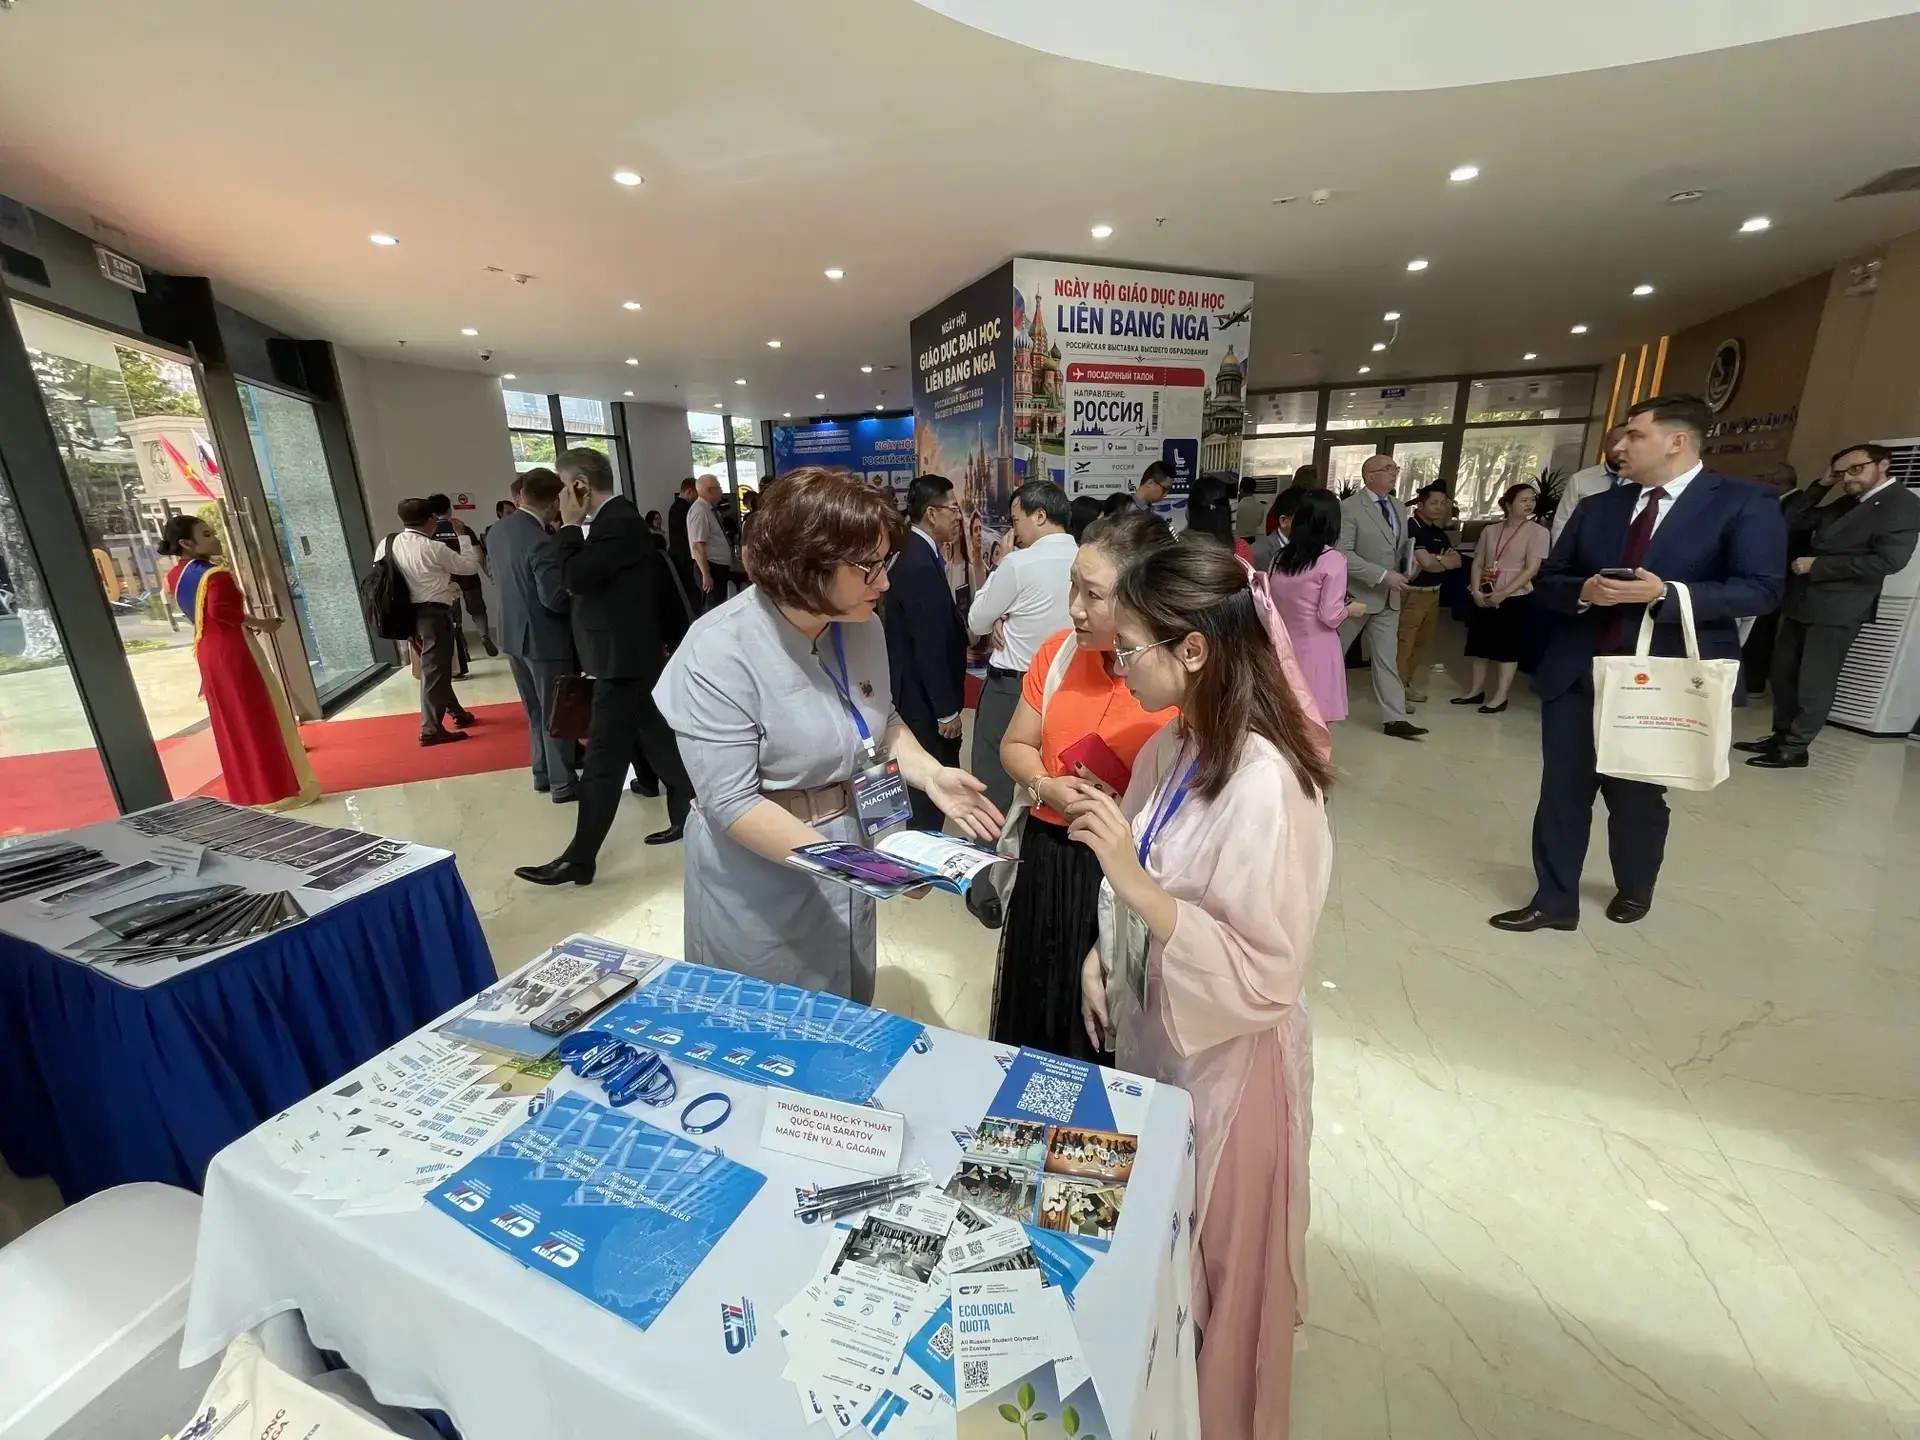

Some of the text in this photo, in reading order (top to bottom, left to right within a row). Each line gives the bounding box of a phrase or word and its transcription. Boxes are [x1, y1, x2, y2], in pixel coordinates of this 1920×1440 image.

[1055, 277, 1225, 312] NGÀY HỘI GIÁO DỤC ĐẠI HỌC
[942, 311, 966, 335] NGÀY HỘI
[1058, 302, 1209, 341] LIÊN BANG NGA
[920, 318, 1000, 371] GIÁO DỤC ĐẠI HỌC
[1066, 341, 1208, 356] РОССИЙСКАЯ ВЫСТАВКА ВЫСШЕГО ОБРАЗОВАНИЯ
[926, 351, 996, 393] LIÊN BANG NGA
[1087, 370, 1154, 381] ПОСАДОЧНЫЙ ТАЛОН
[1074, 390, 1125, 398] НАПРАВЛЕНИЕ:
[1074, 400, 1143, 422] РОССИЯ
[861, 785, 903, 810] УЧАСТНИК
[1022, 1051, 1047, 1060] SARATOV
[1039, 1060, 1087, 1077] STATE TECHNICAL
[1055, 1060, 1088, 1072] UNIVERSITY
[777, 1101, 811, 1115] TRƯỜNG
[813, 1110, 828, 1119] ĐẠI
[830, 1113, 848, 1124] HỌC
[851, 1117, 862, 1126] KỸ
[438, 1129, 478, 1147] ECOLOGICAL
[464, 1125, 488, 1138] QUOTA
[817, 1122, 831, 1132] GIA
[833, 1125, 873, 1141] SARATOV
[775, 1126, 887, 1157] MANG TÊN YU. A. GAGARIN
[571, 1149, 597, 1164] SARATOV
[415, 1164, 445, 1173] OGICAL
[554, 1162, 580, 1177] GAGARIN
[609, 1170, 647, 1190] OF SARATOV
[593, 1185, 636, 1209] YURI GAGARIN
[601, 1177, 691, 1221] STATE TECHNICAL UNIVERSITY
[959, 1302, 1015, 1317] ECOLOGICAL
[960, 1319, 990, 1333] QUOTA
